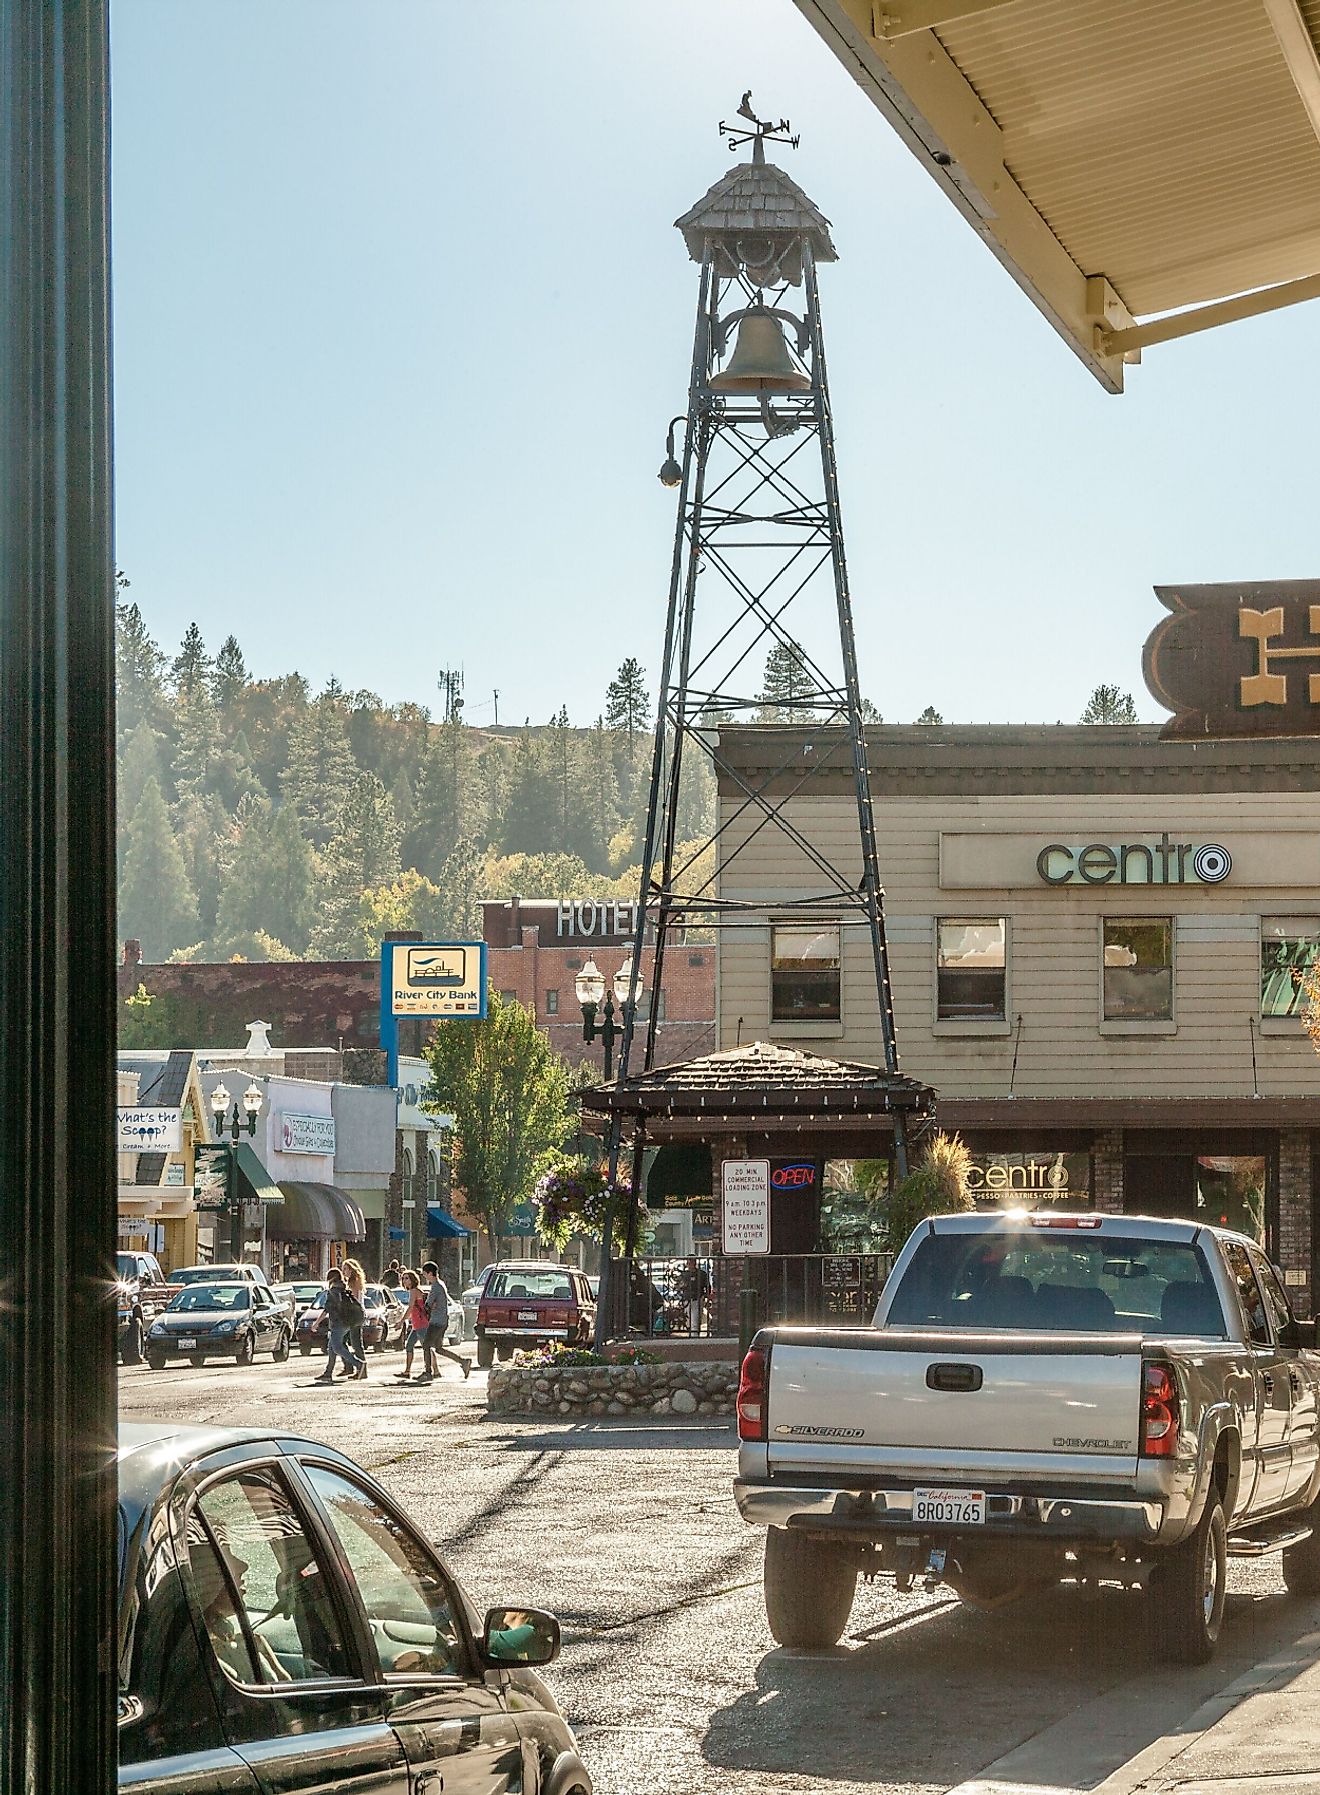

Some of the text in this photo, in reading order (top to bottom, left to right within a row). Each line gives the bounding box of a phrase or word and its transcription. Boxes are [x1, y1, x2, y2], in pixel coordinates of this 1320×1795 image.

[1037, 832, 1232, 884] centro
[395, 990, 477, 999] River City Bank
[158, 1111, 177, 1122] the
[772, 1168, 815, 1185] OPEN
[966, 1160, 1069, 1188] centro
[738, 1223, 765, 1231] PARKING
[791, 1425, 865, 1438] SILVERADO
[1053, 1437, 1132, 1449] CHEVROLET
[928, 1490, 970, 1502] California
[917, 1501, 980, 1521] 8R03765
